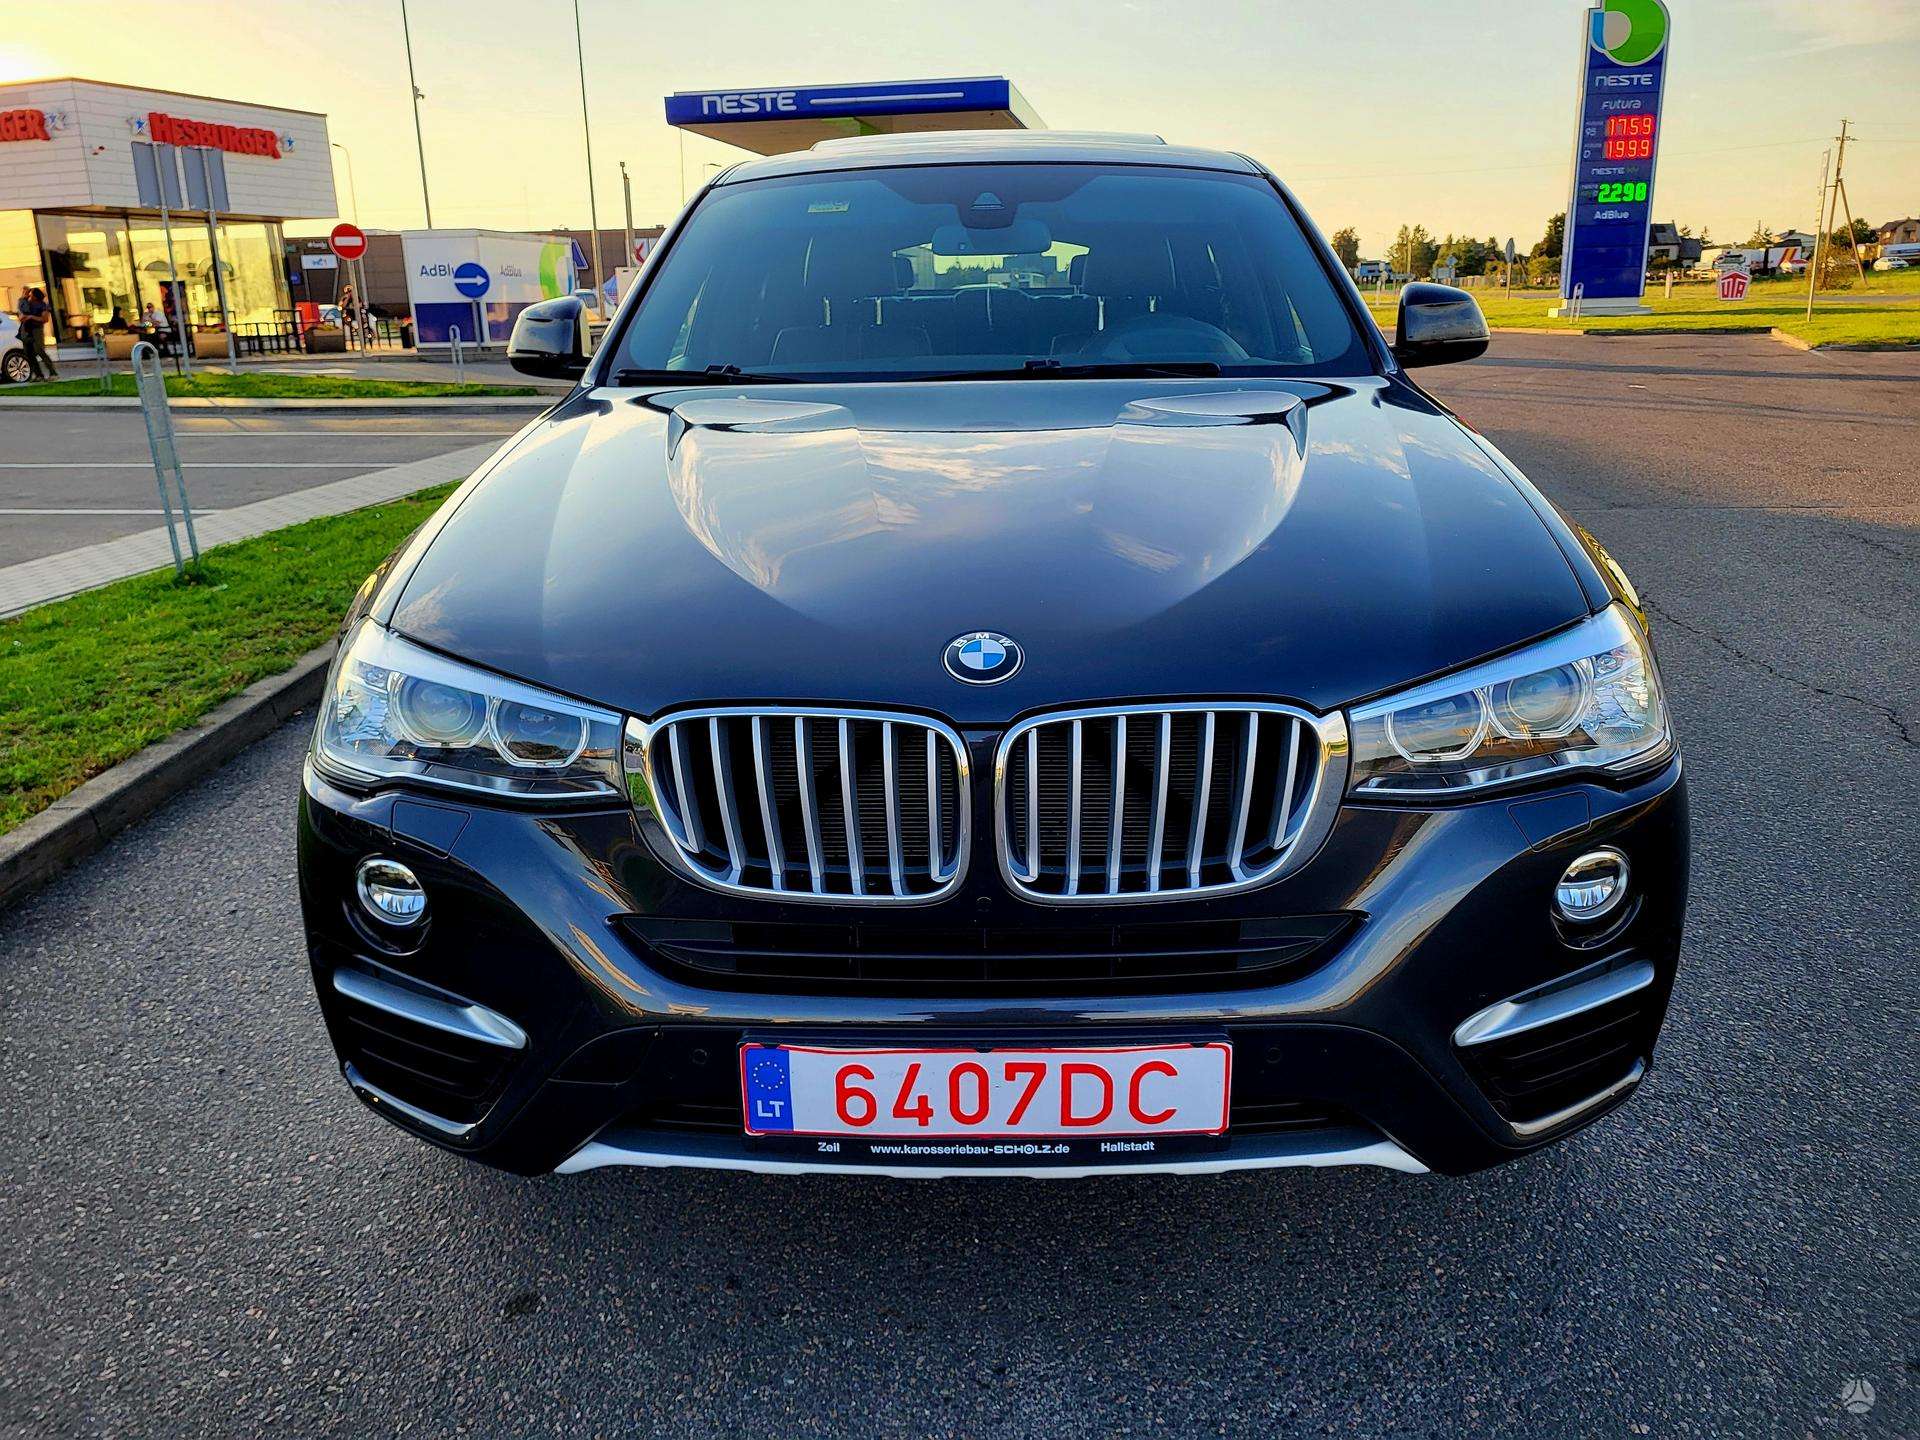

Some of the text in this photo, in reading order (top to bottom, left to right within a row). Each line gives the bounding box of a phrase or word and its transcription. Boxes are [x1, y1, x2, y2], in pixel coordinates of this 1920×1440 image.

[1595, 73, 1653, 87] NESTE
[702, 91, 797, 115] NESTE
[1601, 99, 1642, 110] Futura
[149, 112, 281, 159] HESBURGER
[1610, 117, 1652, 136] 1759
[1608, 139, 1650, 158] 1999
[1593, 210, 1630, 219] AdBlue
[420, 262, 454, 277] AdBl
[1721, 271, 1748, 299] UTA
[951, 632, 1014, 648] BMW
[834, 1061, 1179, 1128] 6407DC
[756, 1100, 785, 1118] LT
[817, 1141, 1155, 1154] Zeil www.karosseriebau-SCHOLZ.de Hallstadt
